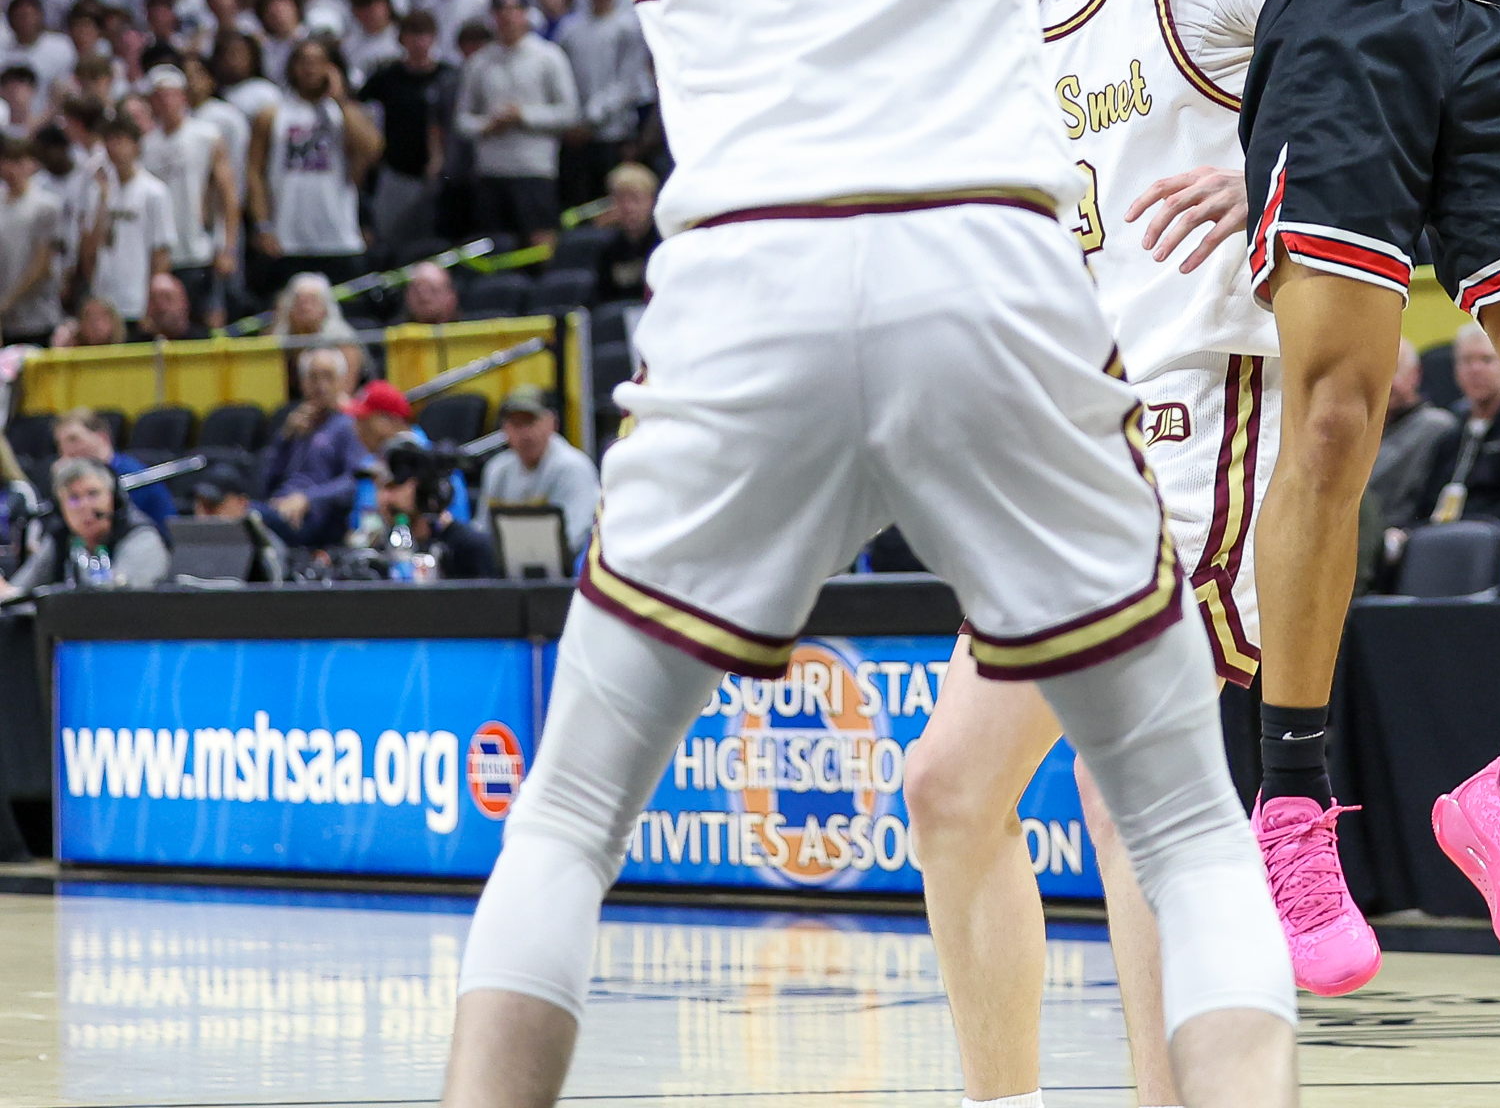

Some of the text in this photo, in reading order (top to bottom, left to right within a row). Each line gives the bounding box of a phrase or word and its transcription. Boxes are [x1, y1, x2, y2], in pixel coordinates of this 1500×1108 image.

[1055, 59, 1152, 139] Smet
[1145, 402, 1191, 447] D
[701, 662, 843, 718] SOURI
[62, 709, 459, 834] www.mshsaa.org
[674, 736, 918, 793] HIGH SCHO
[629, 811, 789, 869] TIVITIES
